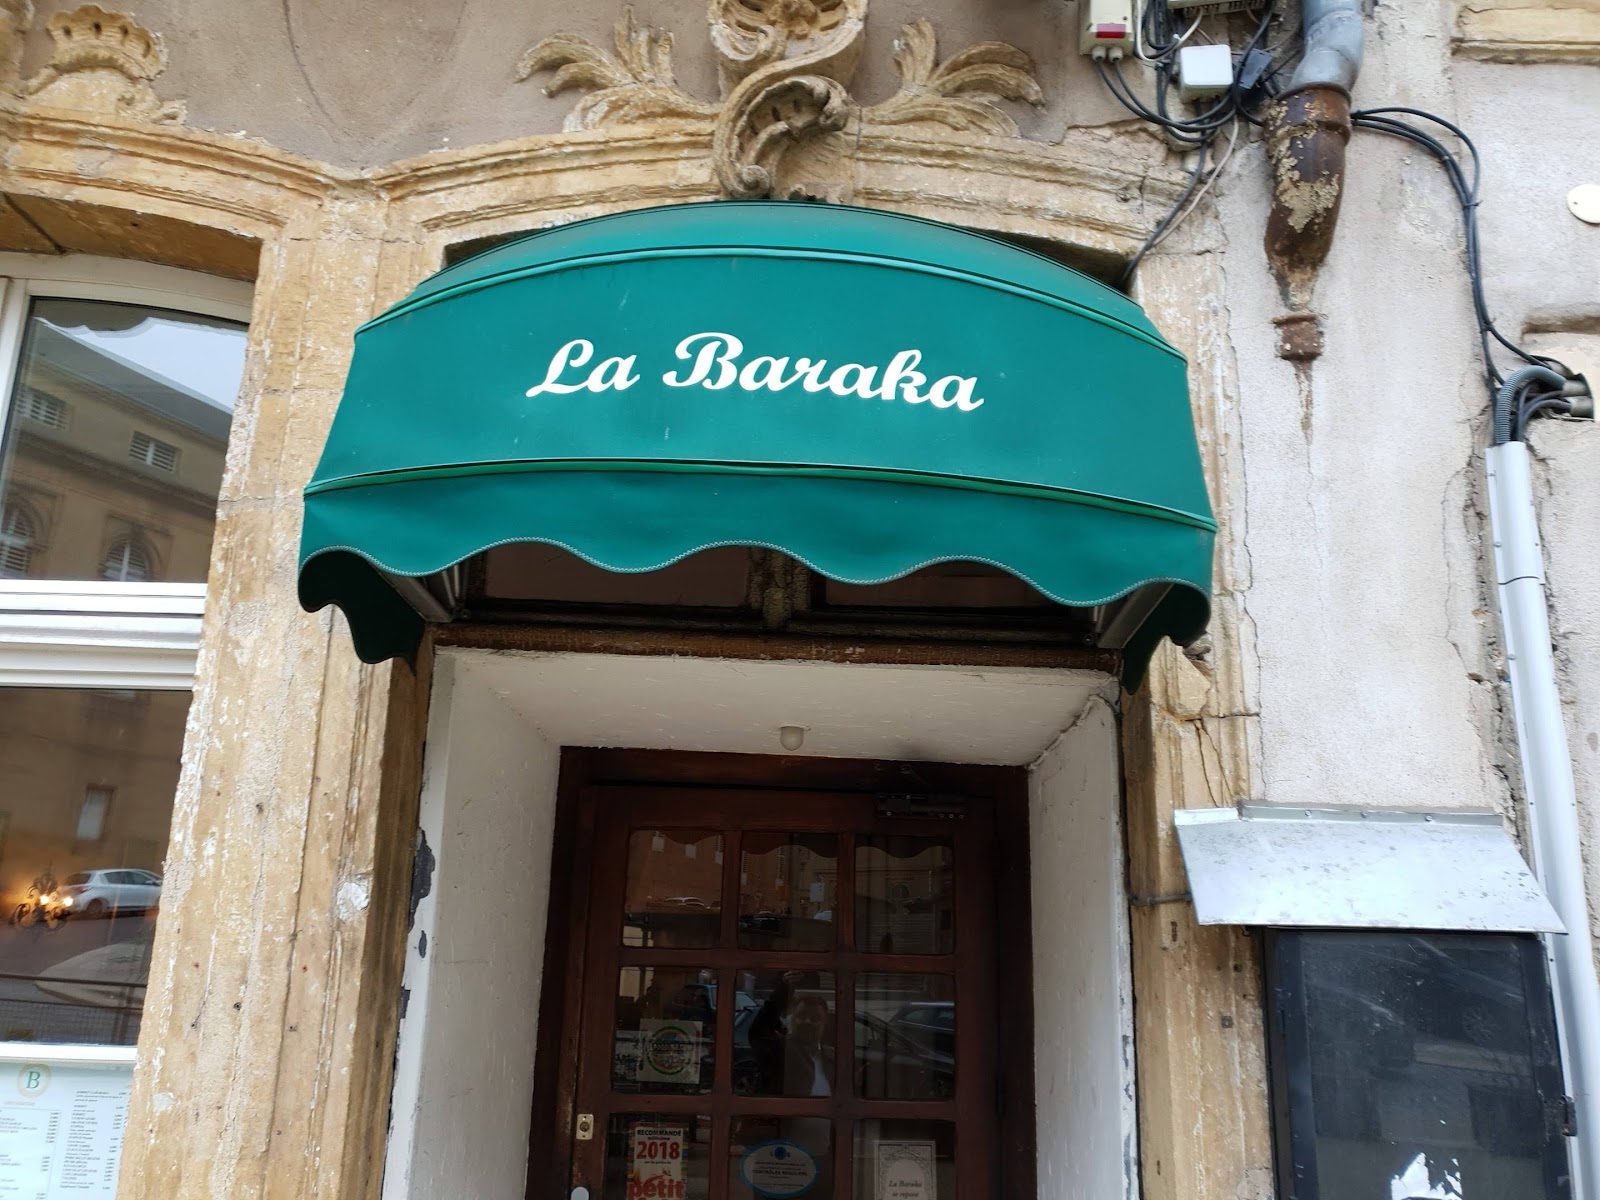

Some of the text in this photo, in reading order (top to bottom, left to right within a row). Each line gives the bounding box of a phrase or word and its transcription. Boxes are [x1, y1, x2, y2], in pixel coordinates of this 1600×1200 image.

[525, 331, 985, 412] La Baraka
[26, 1071, 41, 1089] B
[636, 1141, 680, 1160] 2018
